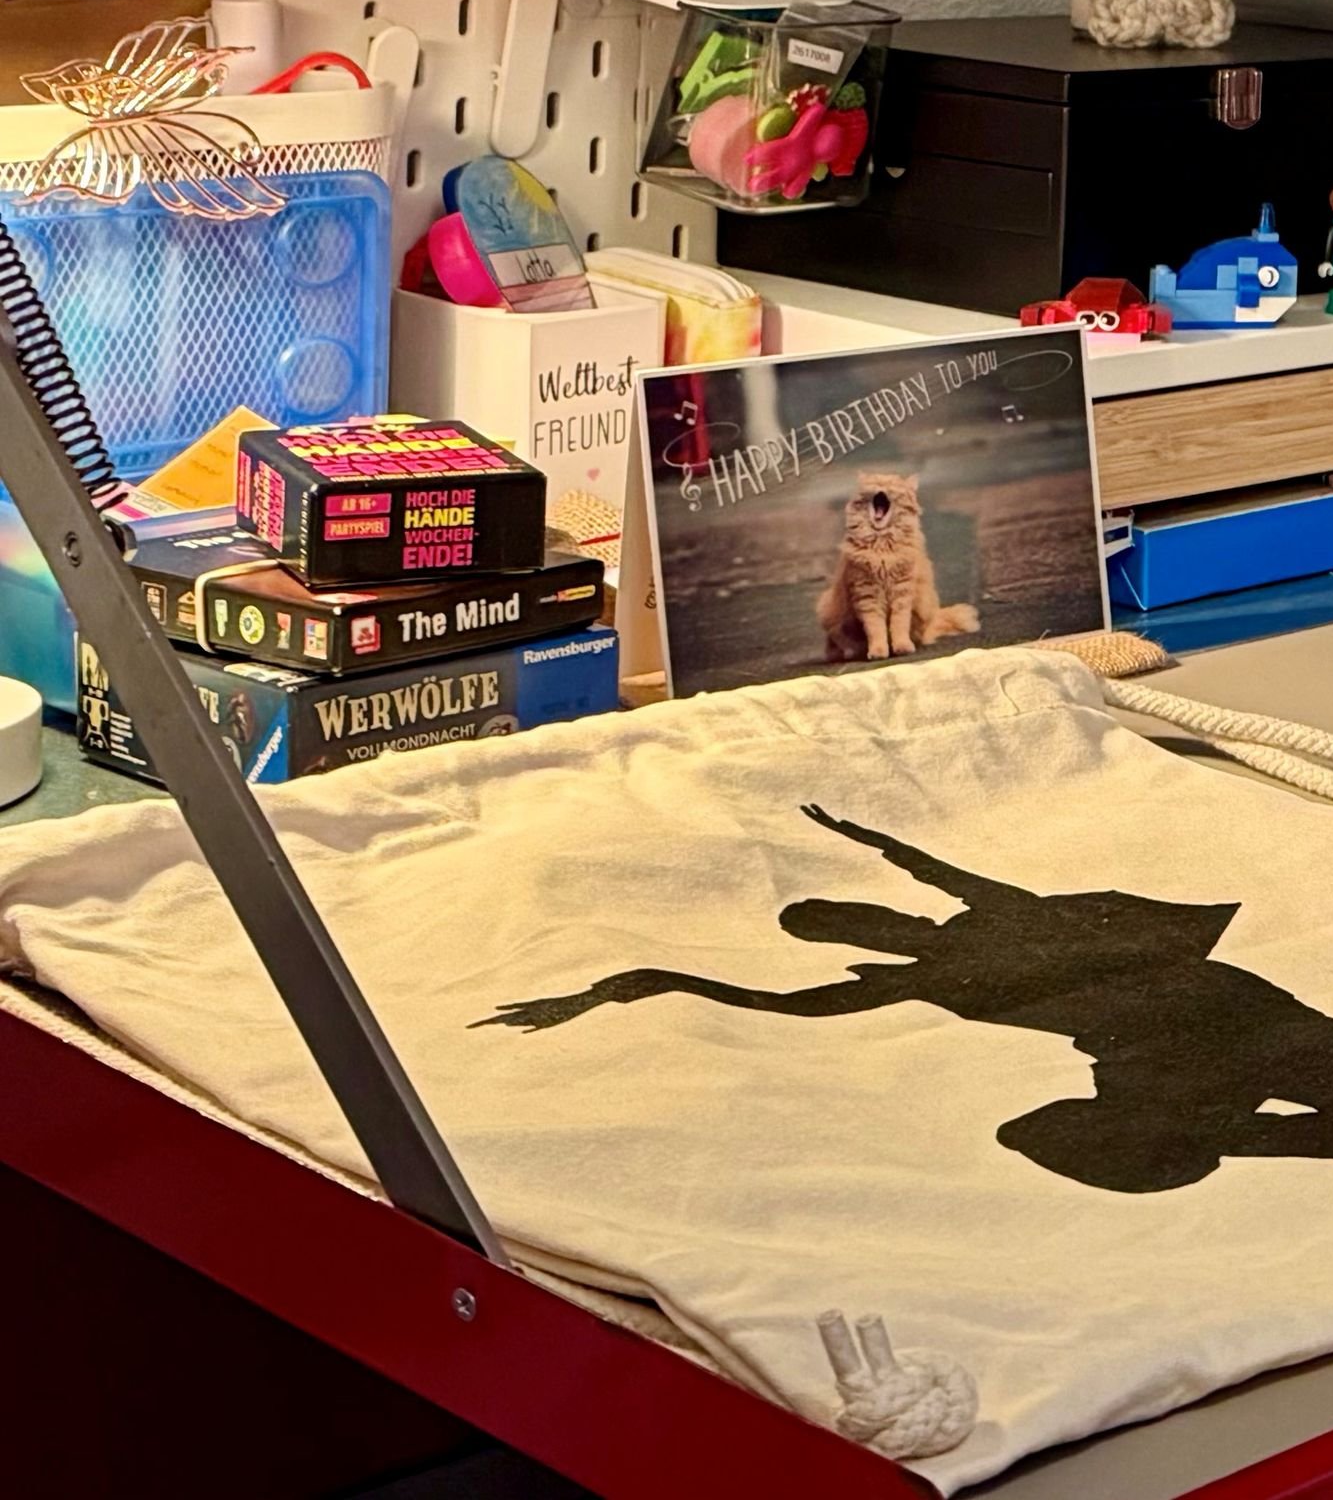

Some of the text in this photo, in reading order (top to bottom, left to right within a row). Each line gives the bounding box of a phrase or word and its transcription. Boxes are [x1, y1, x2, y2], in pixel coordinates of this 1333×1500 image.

[539, 356, 640, 403] Weltbest
[534, 408, 626, 459] FREUND
[709, 349, 998, 506] HAPPY BIRTHDAY TO YOU
[406, 489, 476, 508] HOCH DIE
[330, 521, 385, 536] PARTYSPIEL
[404, 506, 475, 529] HÄNDE
[405, 527, 480, 544] WOCHEN-
[403, 543, 473, 570] ENDE!
[398, 610, 447, 642] The
[456, 592, 520, 632] Mind
[524, 635, 616, 665] Ravensburger
[314, 671, 499, 742] WERWÖLFE
[347, 723, 477, 761] VOLLMONDNACHT
